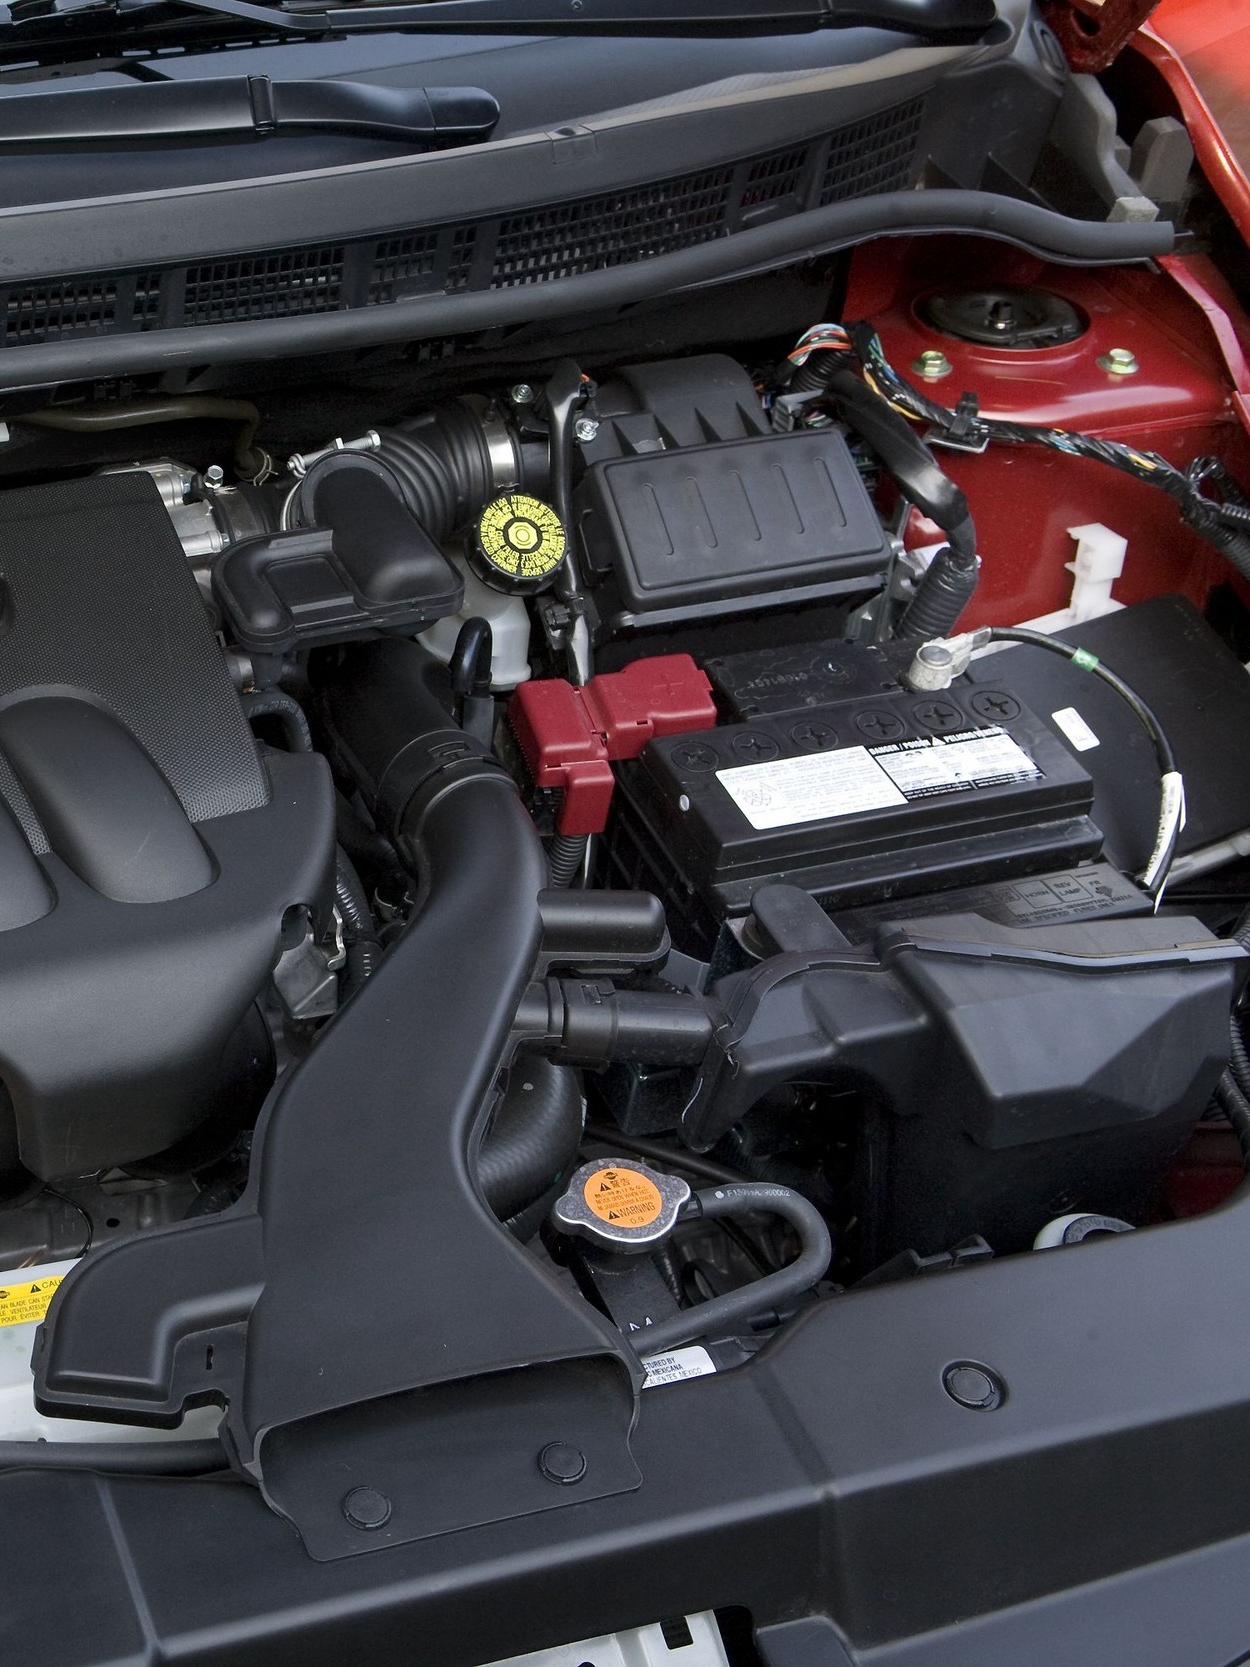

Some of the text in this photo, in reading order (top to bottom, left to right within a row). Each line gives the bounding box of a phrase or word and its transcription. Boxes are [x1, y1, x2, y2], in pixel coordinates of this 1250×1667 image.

[510, 495, 539, 507] ATTENTION
[538, 503, 561, 527] NETTOYER
[1025, 890, 1050, 899] HORN
[1059, 887, 1081, 897] LAMP
[617, 1202, 656, 1217] WARNING
[630, 1216, 645, 1225] 0.9
[10, 1300, 27, 1308] BLADE
[28, 1297, 40, 1305] CAN
[0, 1303, 47, 1317] LE VENTILATEUR
[1, 1315, 17, 1324] POUR
[667, 1356, 676, 1365] BY
[652, 1363, 684, 1376] MEXICANA
[679, 1367, 702, 1378] MEXICO
